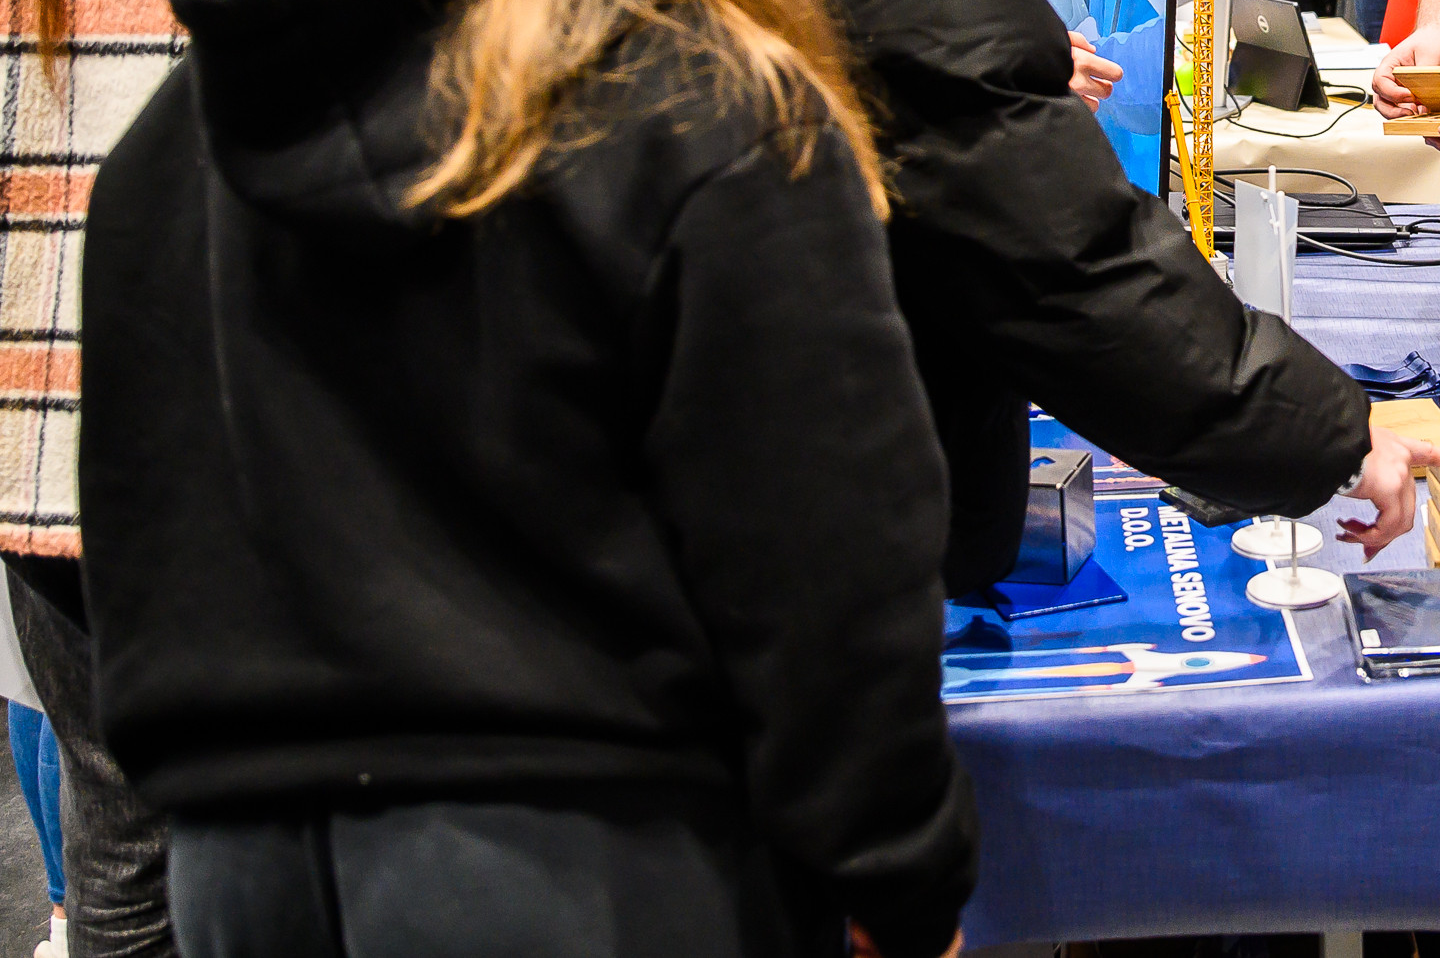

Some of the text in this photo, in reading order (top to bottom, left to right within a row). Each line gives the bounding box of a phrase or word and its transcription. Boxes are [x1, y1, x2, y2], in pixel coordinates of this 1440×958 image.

[1119, 506, 1155, 553] D.O.O.
[1157, 506, 1216, 641] METALNA SENOVO
